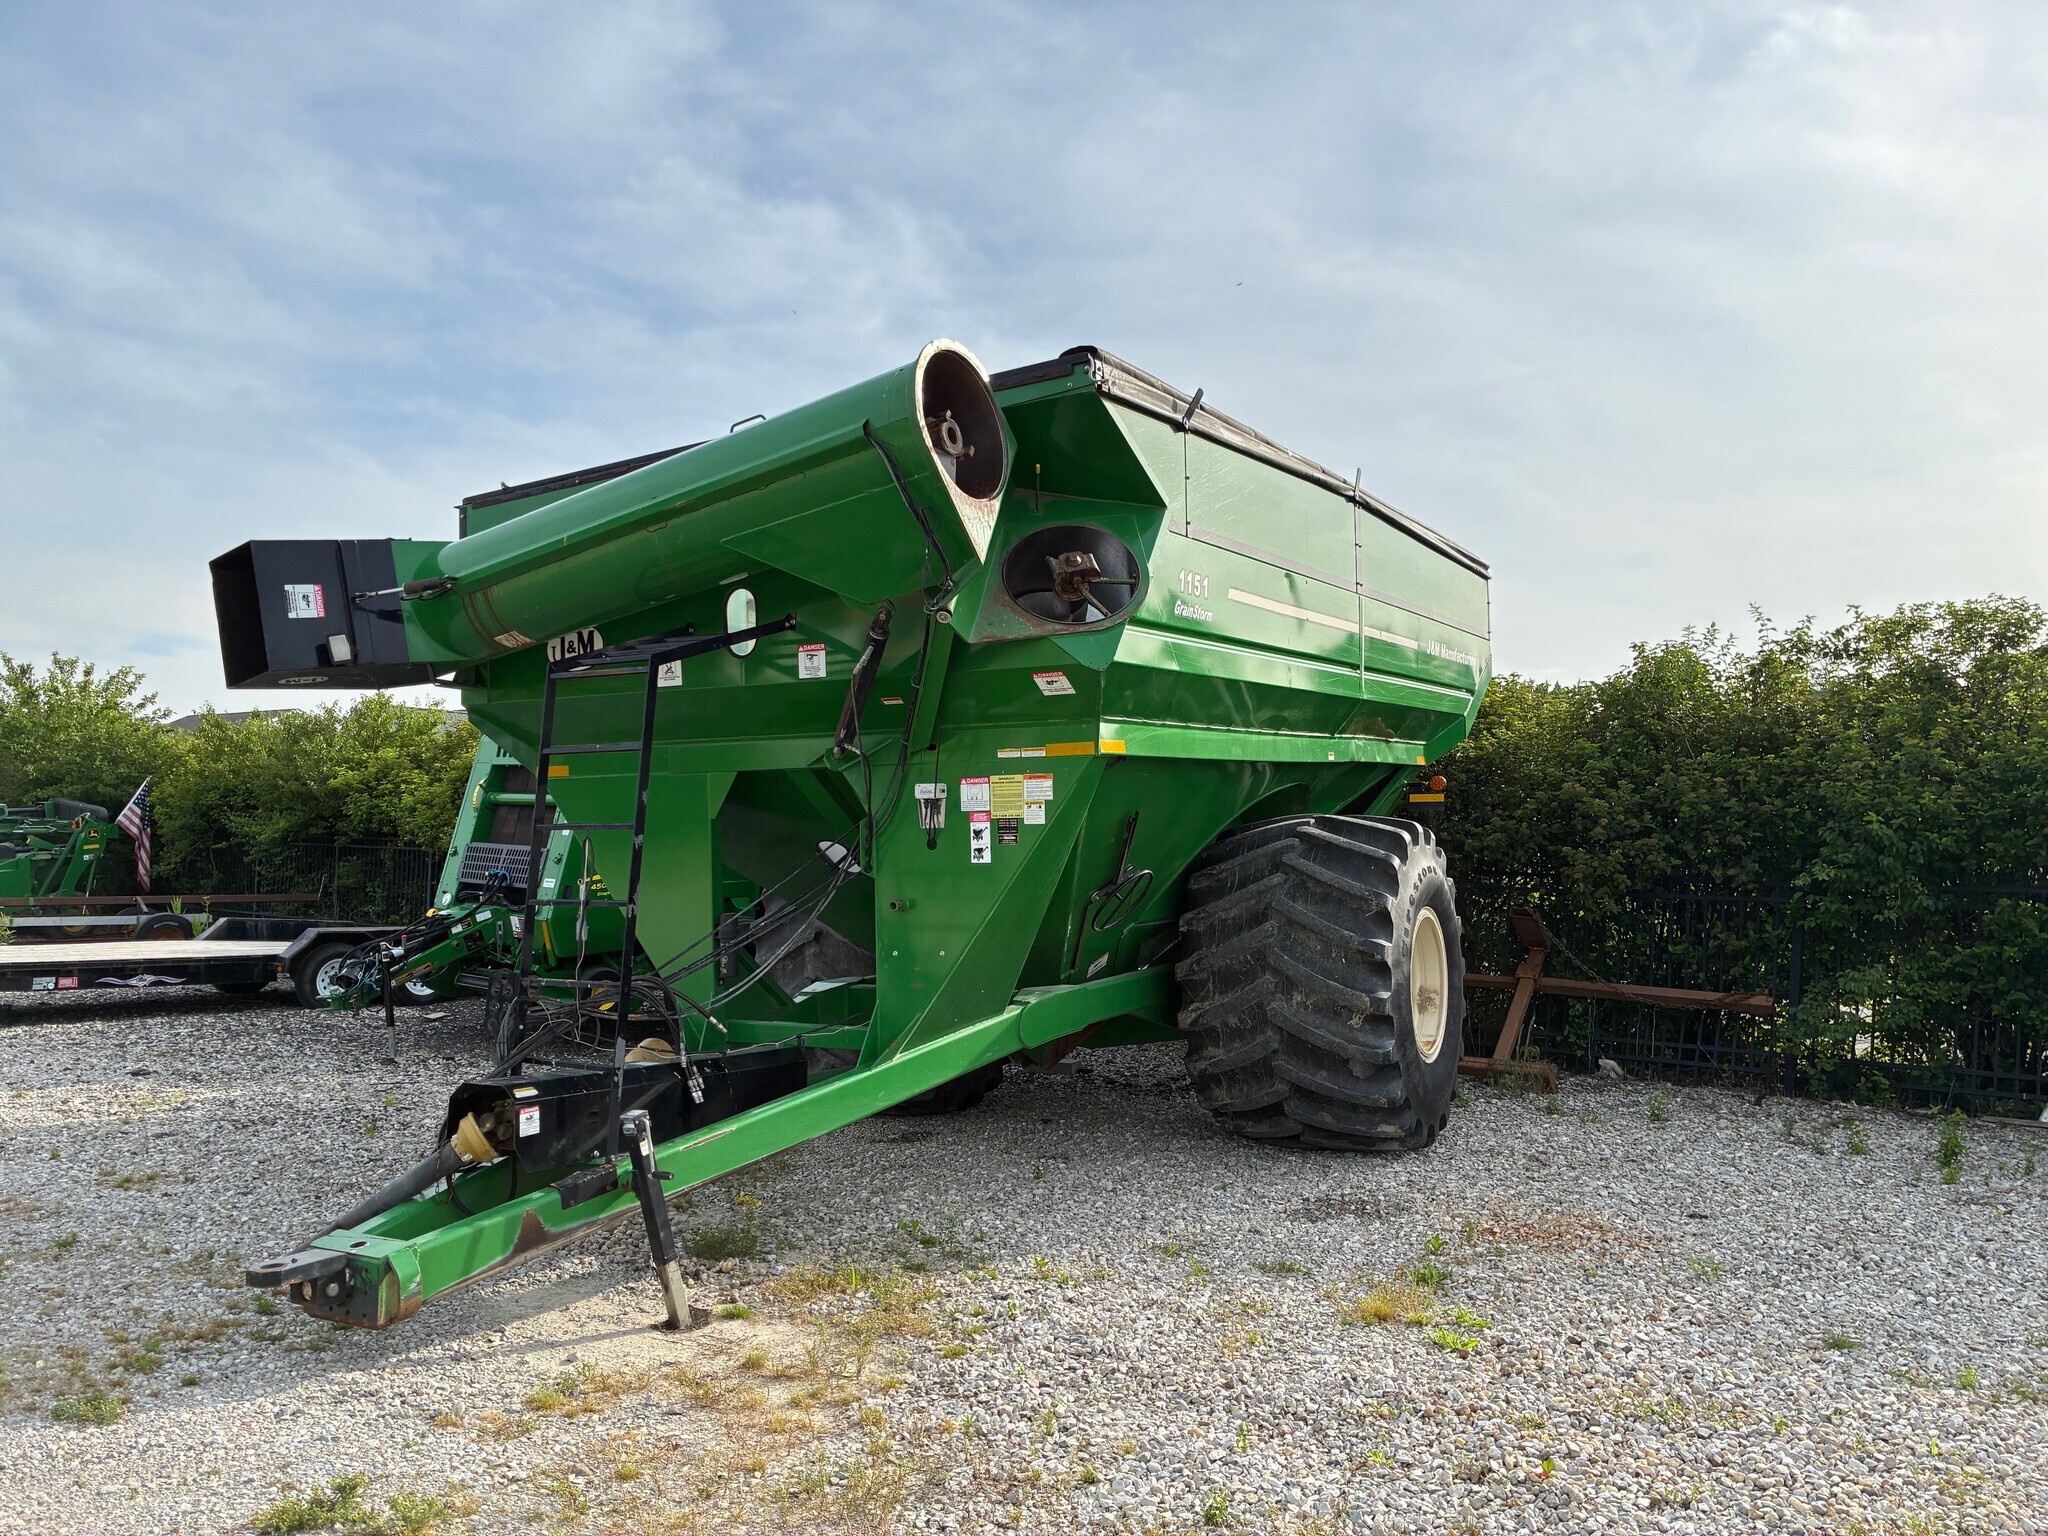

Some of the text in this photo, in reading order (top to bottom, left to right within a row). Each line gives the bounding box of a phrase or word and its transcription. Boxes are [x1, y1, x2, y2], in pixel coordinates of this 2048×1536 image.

[1178, 568, 1209, 599] 1151
[315, 591, 325, 617] DANGER
[1174, 600, 1214, 622] GrainStorm
[551, 630, 595, 662] J&M
[803, 643, 825, 651] DANGER
[1426, 639, 1440, 656] J&M
